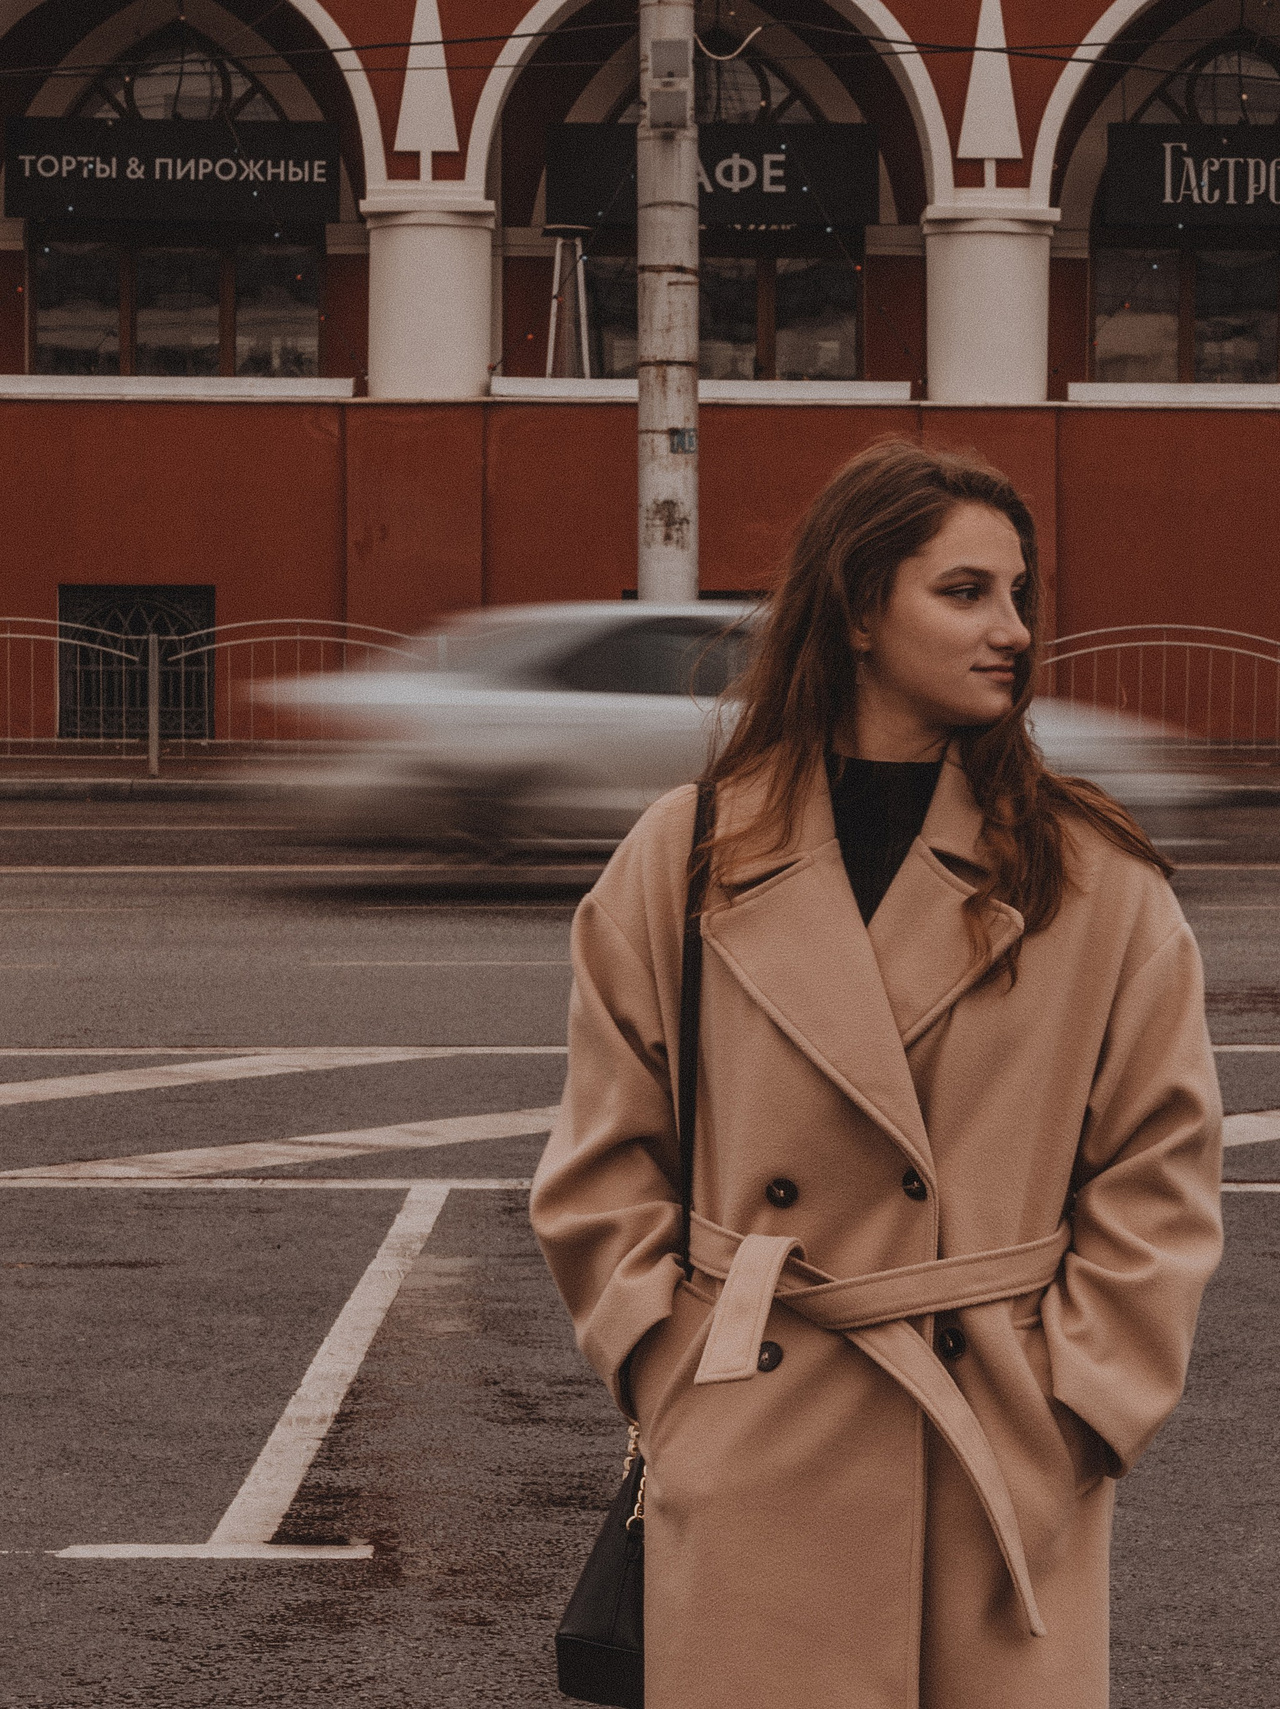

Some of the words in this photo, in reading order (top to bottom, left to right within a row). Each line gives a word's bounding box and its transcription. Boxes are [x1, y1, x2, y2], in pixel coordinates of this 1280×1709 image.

[18, 154, 117, 178] ТОРТЫ
[126, 157, 145, 180] &
[154, 158, 327, 183] ПИРОЖНЫЕ
